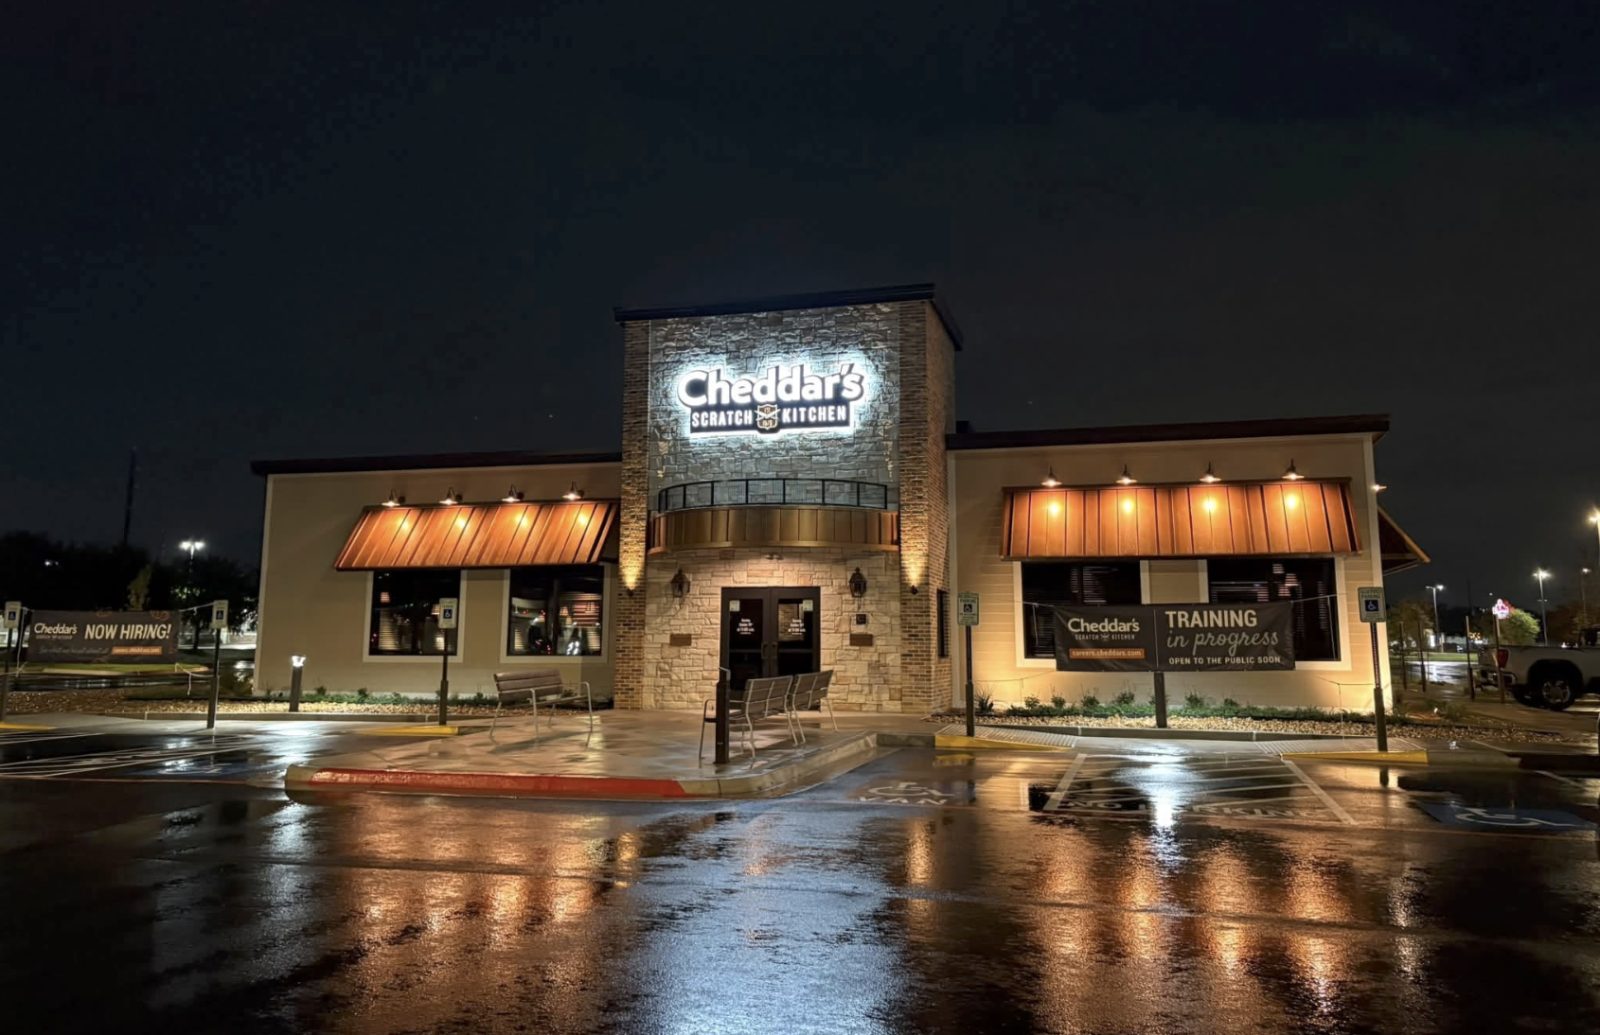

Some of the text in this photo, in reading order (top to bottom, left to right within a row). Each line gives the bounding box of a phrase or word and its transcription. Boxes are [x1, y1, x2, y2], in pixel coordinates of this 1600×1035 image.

[677, 362, 865, 408] Cheddar's
[691, 409, 753, 428] SCRATCH
[782, 405, 847, 424] KITCHEN
[1067, 617, 1140, 633] Cheddar's
[1165, 609, 1258, 628] TRAINING
[84, 623, 172, 640] NOW HIRING!
[1167, 630, 1279, 657] in progress
[1168, 655, 1281, 665] OPEN TO THE PUBLIC SOON
